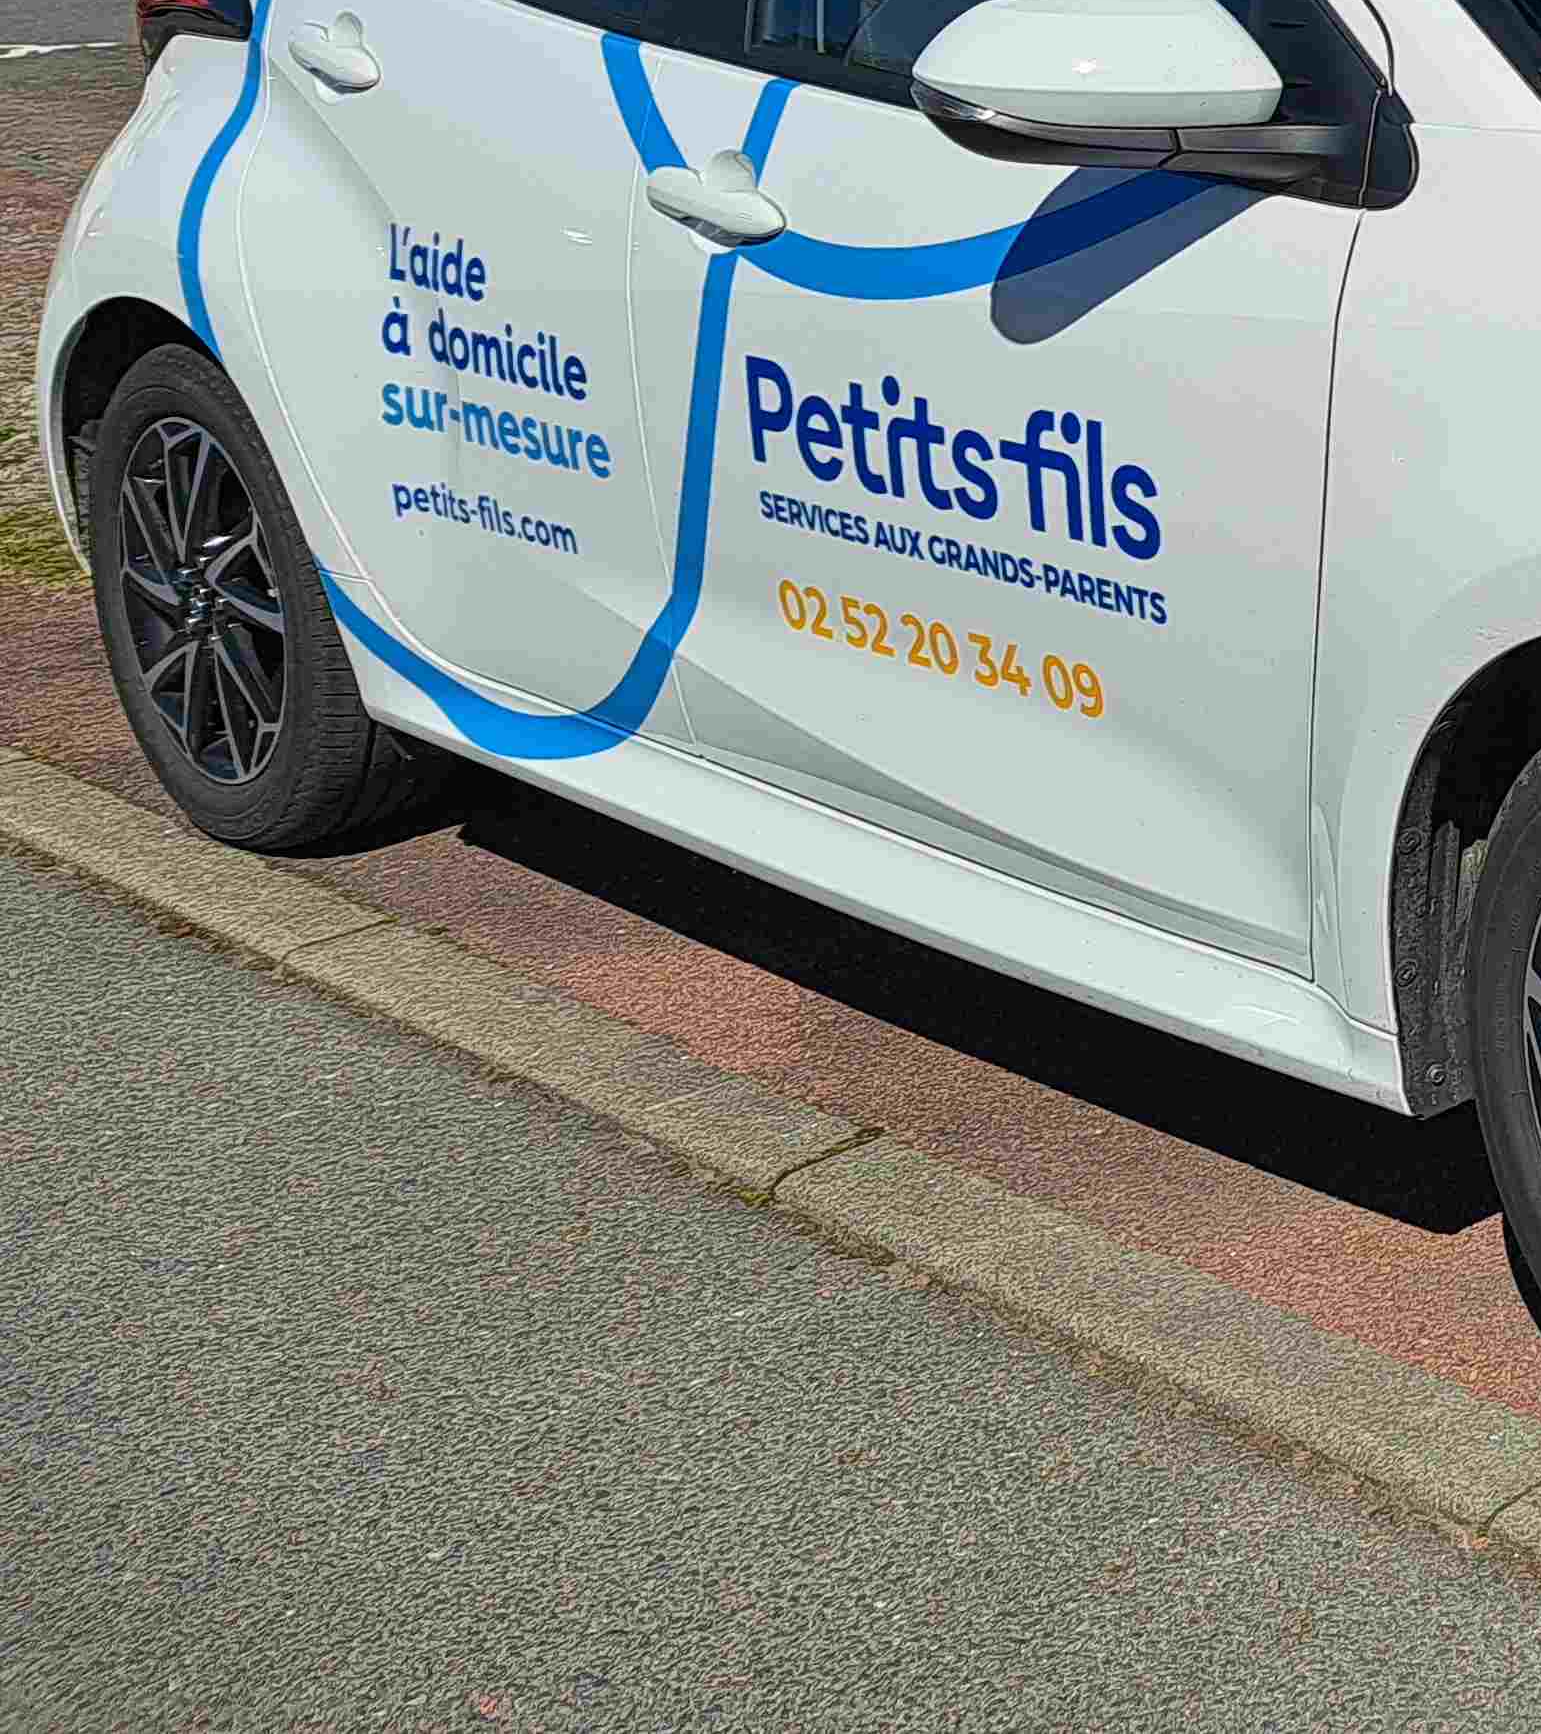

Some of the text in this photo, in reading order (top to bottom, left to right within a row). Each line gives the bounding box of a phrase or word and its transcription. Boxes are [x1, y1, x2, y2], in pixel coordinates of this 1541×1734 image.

[389, 223, 486, 301] L'aide
[381, 297, 588, 402] à domicile
[381, 380, 611, 479] sur-mesure
[392, 478, 579, 556] petits-fils.com
[759, 489, 1168, 625] SERVICES AUX GRANDS-PARENTS
[778, 578, 1105, 720] 02 52 20 34 09
